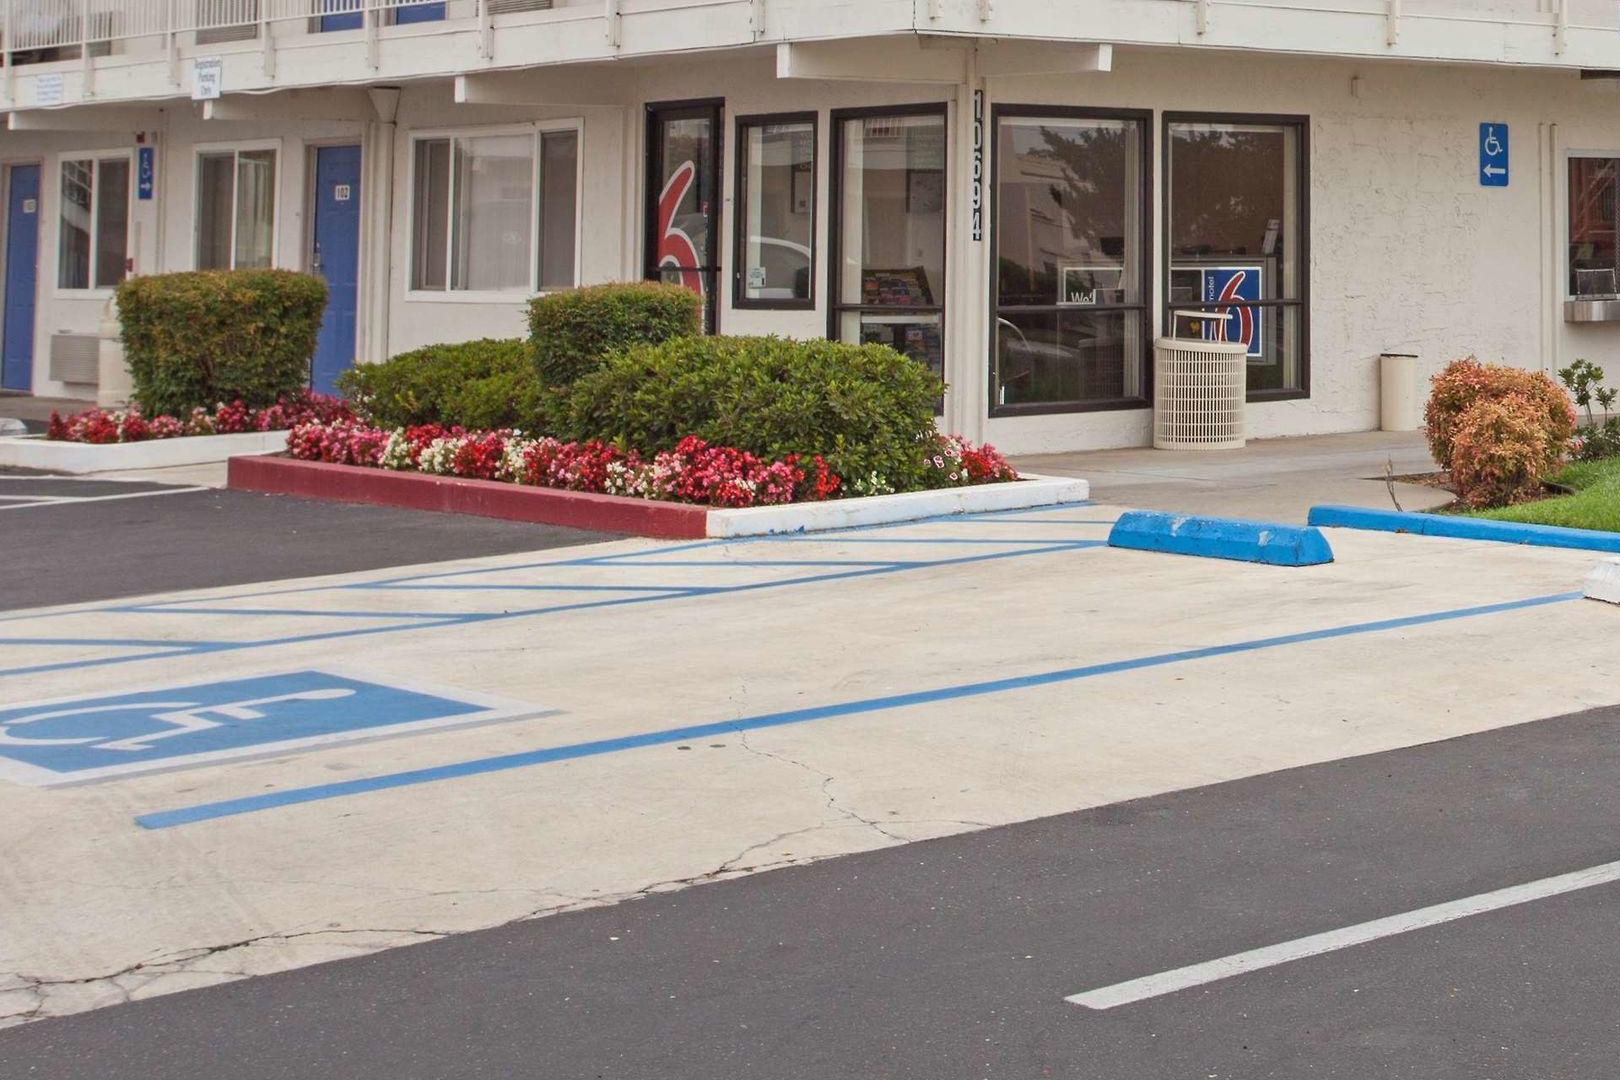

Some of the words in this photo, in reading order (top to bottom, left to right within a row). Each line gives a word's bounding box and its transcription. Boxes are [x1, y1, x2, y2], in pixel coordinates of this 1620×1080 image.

[337, 186, 349, 199] 102
[972, 89, 984, 241] 10694
[1213, 271, 1254, 350] 6
